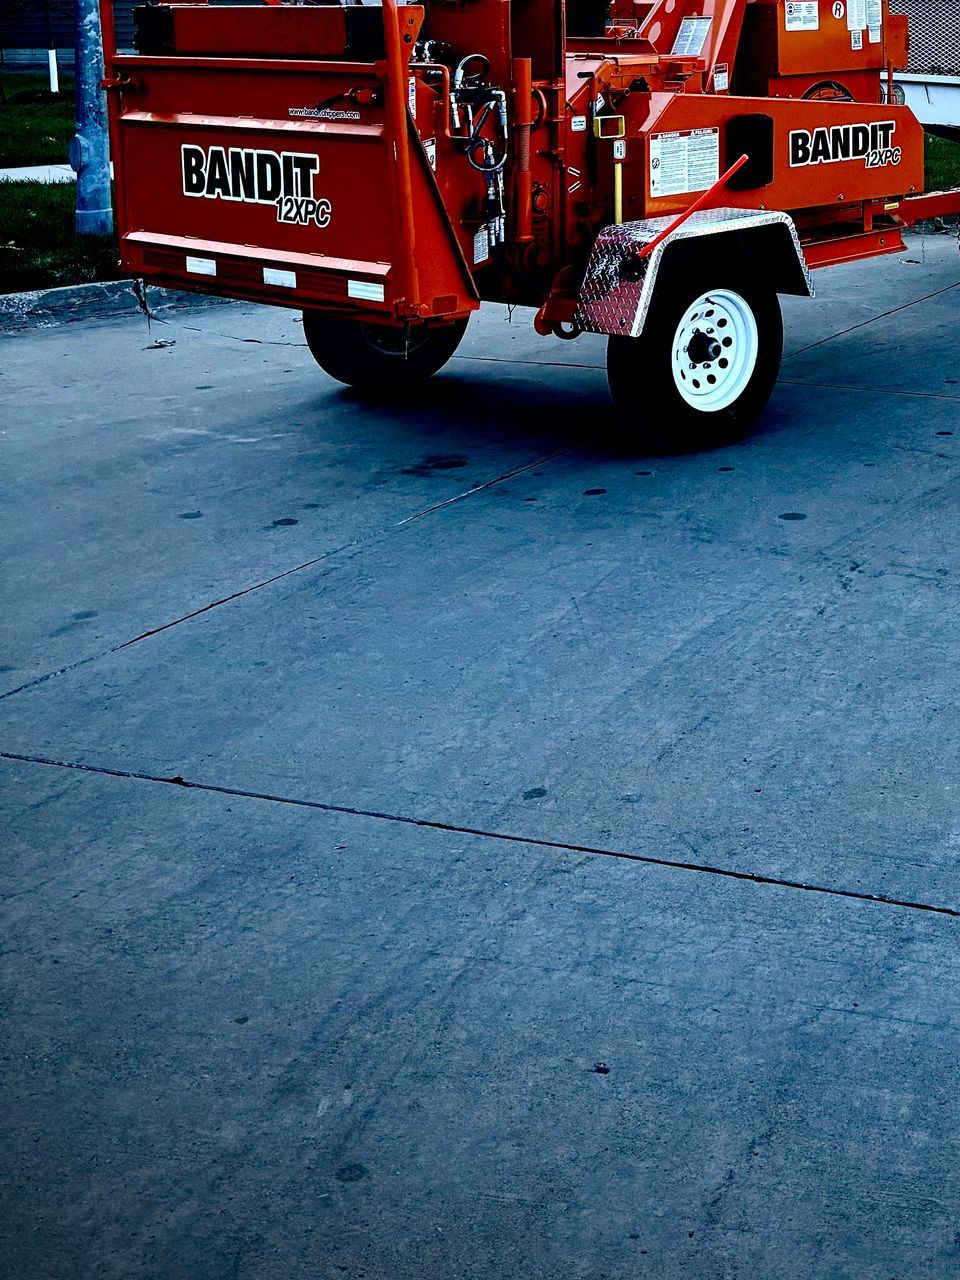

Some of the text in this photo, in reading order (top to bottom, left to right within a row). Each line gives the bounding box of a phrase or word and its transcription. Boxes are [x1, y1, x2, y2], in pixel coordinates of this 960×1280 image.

[790, 121, 895, 166] BANDIT
[865, 148, 901, 168] 12XPC
[182, 145, 319, 204] BANDIT
[276, 197, 331, 227] 12XPC
